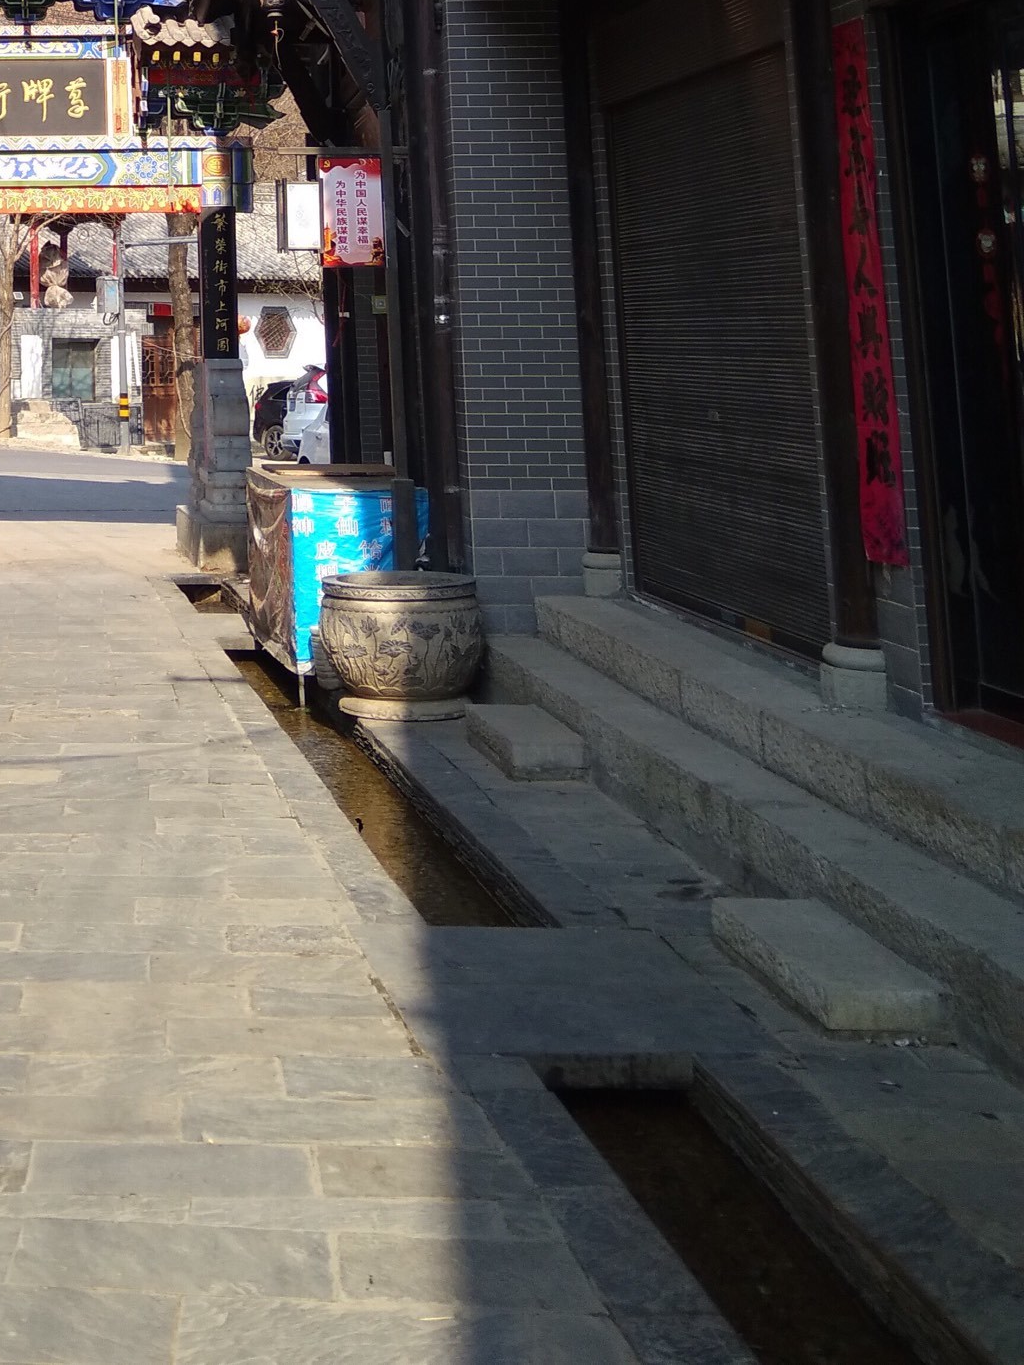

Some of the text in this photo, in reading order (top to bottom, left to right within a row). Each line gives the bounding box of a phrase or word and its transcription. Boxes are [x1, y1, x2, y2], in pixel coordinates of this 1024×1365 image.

[335, 180, 350, 254] 为中华民族谋复兴
[354, 170, 370, 244] 为中国人民谋幸福
